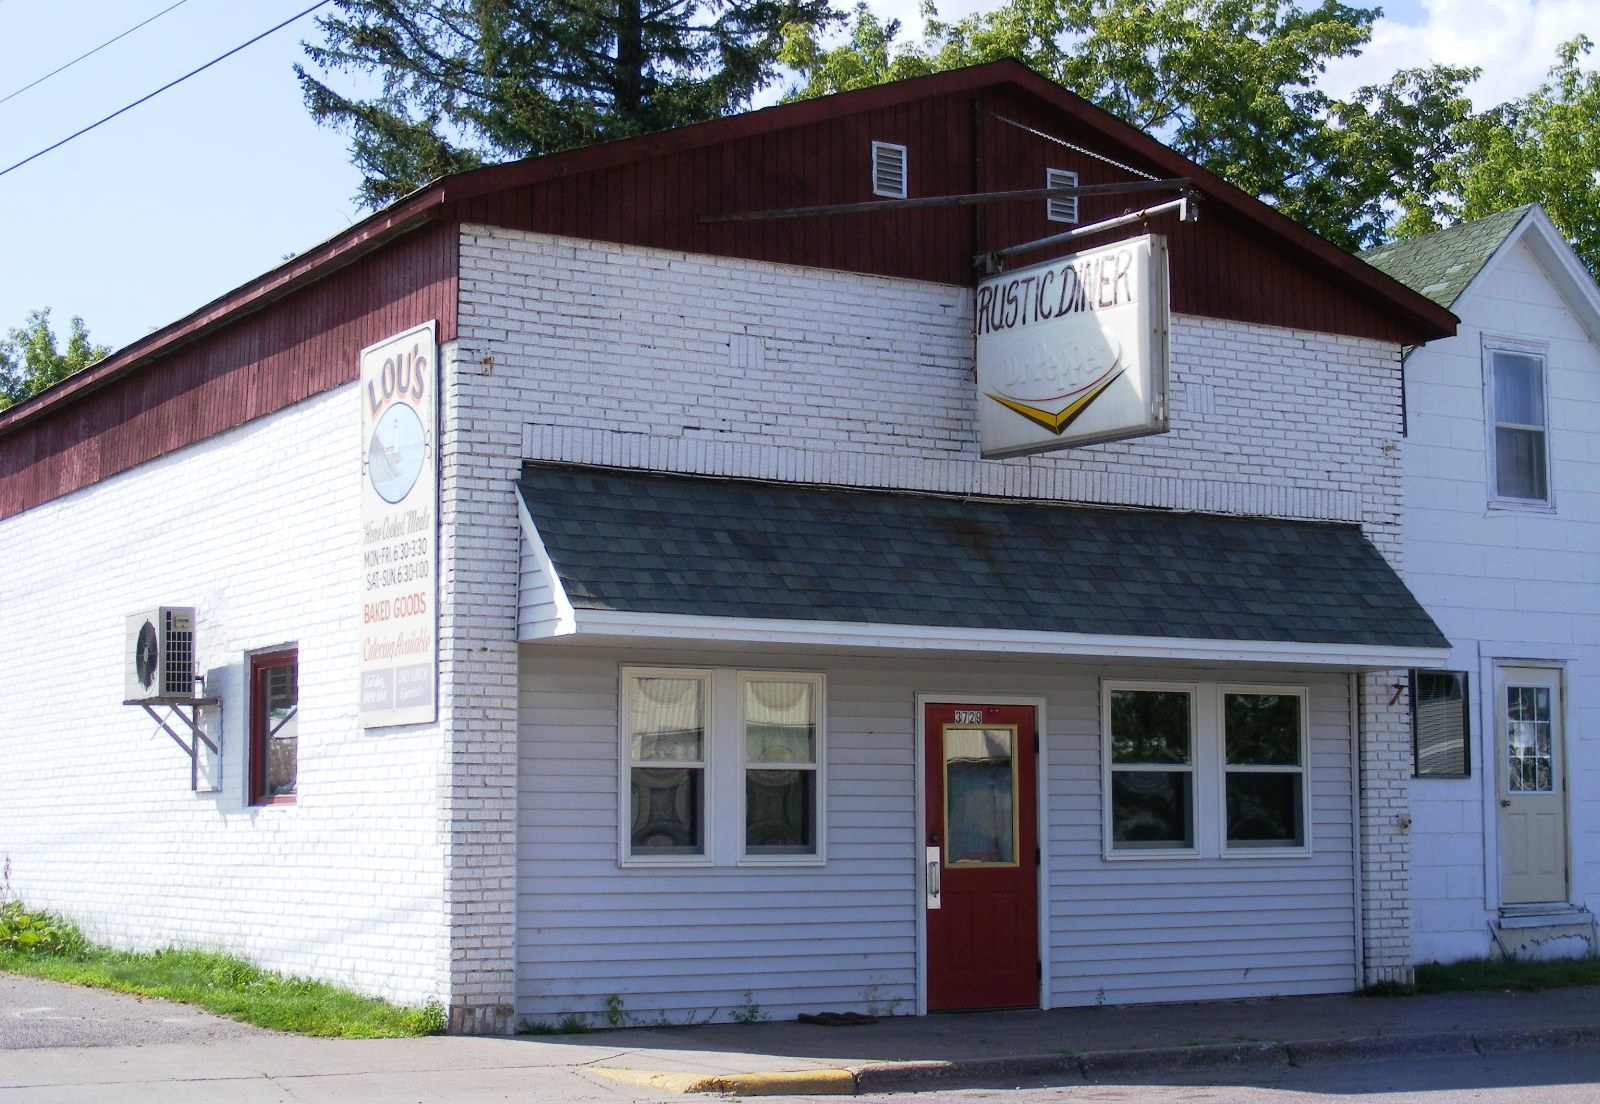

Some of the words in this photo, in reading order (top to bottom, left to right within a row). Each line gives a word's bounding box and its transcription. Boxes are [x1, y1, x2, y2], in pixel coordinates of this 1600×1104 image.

[978, 271, 1054, 335] RUSTIC
[1053, 250, 1132, 319] DINER
[368, 343, 427, 421] LOU'S
[364, 600, 390, 624] BAKED
[394, 591, 426, 618] GOODS
[955, 711, 982, 724] 3729
